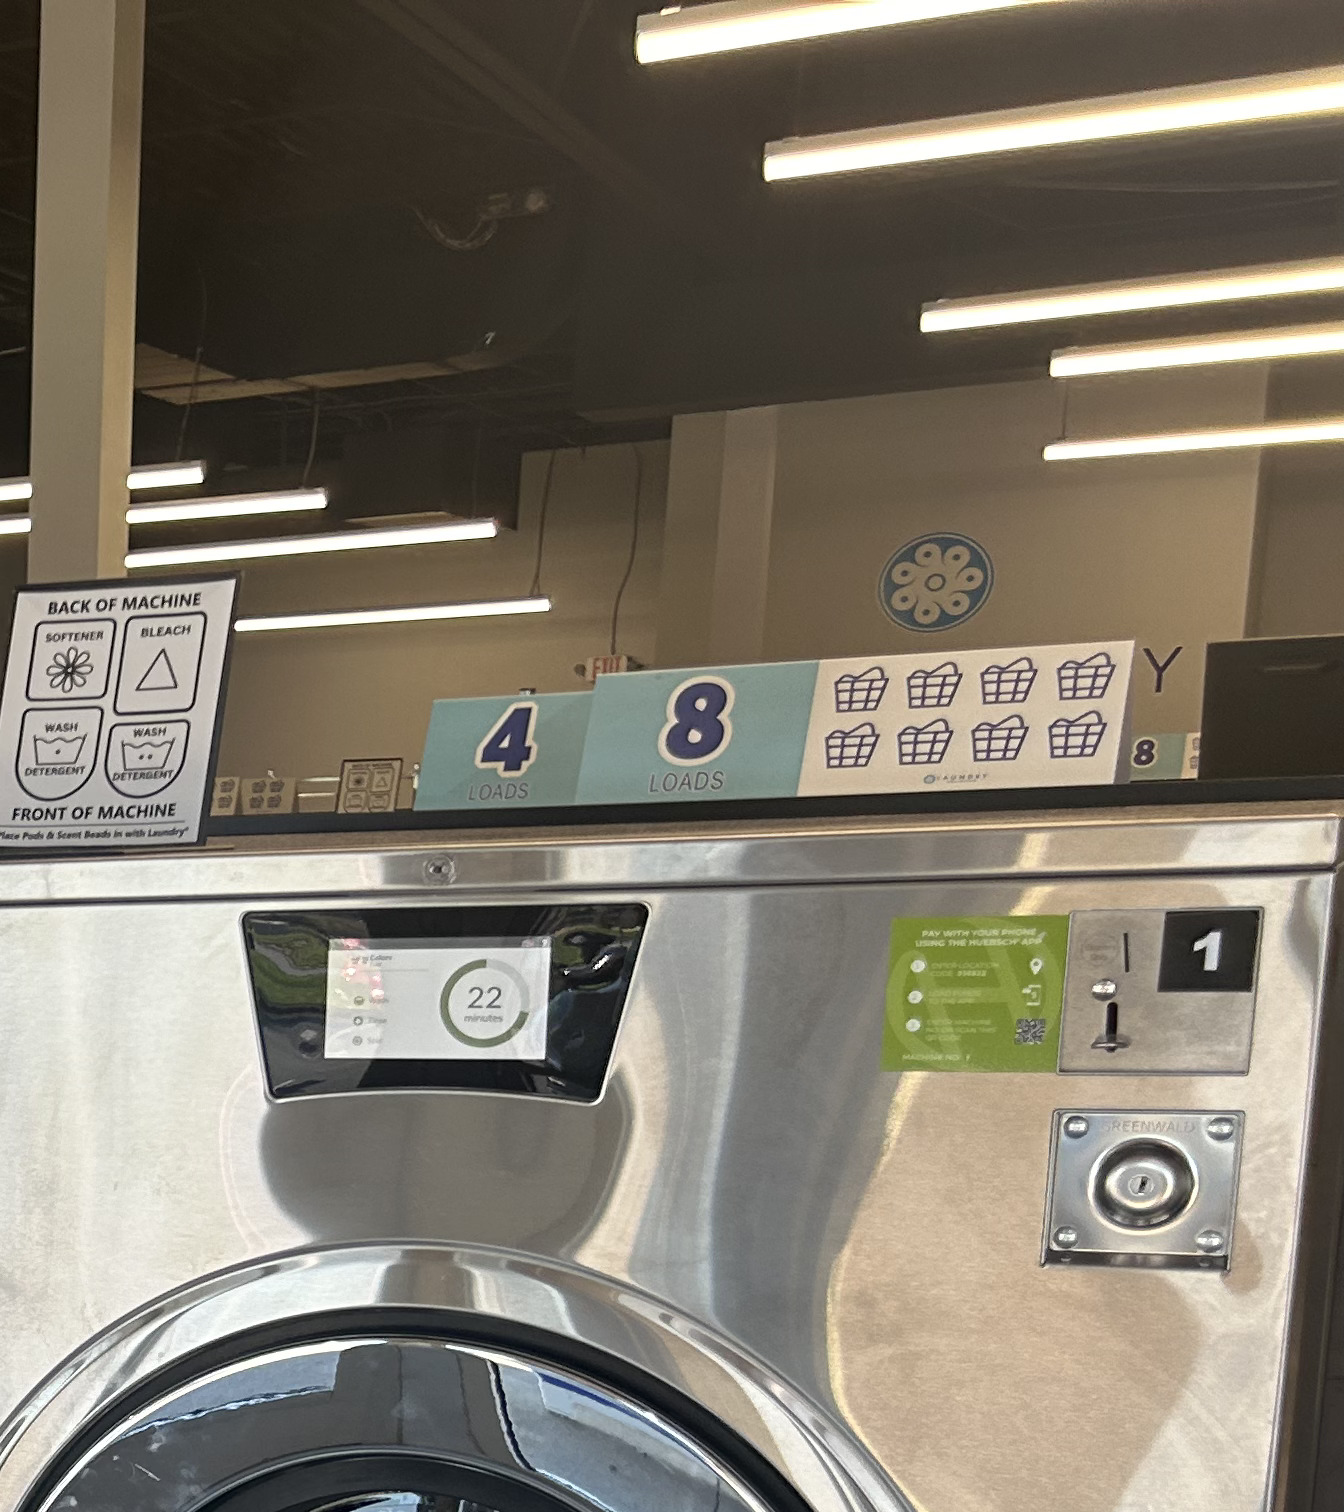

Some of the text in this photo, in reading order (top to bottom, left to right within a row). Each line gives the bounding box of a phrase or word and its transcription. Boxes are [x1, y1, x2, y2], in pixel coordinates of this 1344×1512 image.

[48, 592, 202, 615] BACK OF MACHINE
[45, 630, 104, 643] SOFTENER
[140, 624, 191, 638] BLEACH
[1143, 646, 1183, 693] Y
[45, 722, 78, 733] WASH
[665, 682, 728, 760] 8
[133, 727, 167, 738] WASH
[480, 706, 533, 772] 4
[1132, 738, 1157, 767] 8
[25, 765, 86, 776] DETERGENT
[112, 769, 174, 781] DETERGENT
[649, 770, 725, 793] LOADS
[469, 782, 529, 801] LOADS
[12, 803, 177, 821] FRONT OF MACHINE
[1192, 930, 1223, 972] 1
[467, 986, 502, 1009] 22
[464, 1014, 504, 1023] minutes
